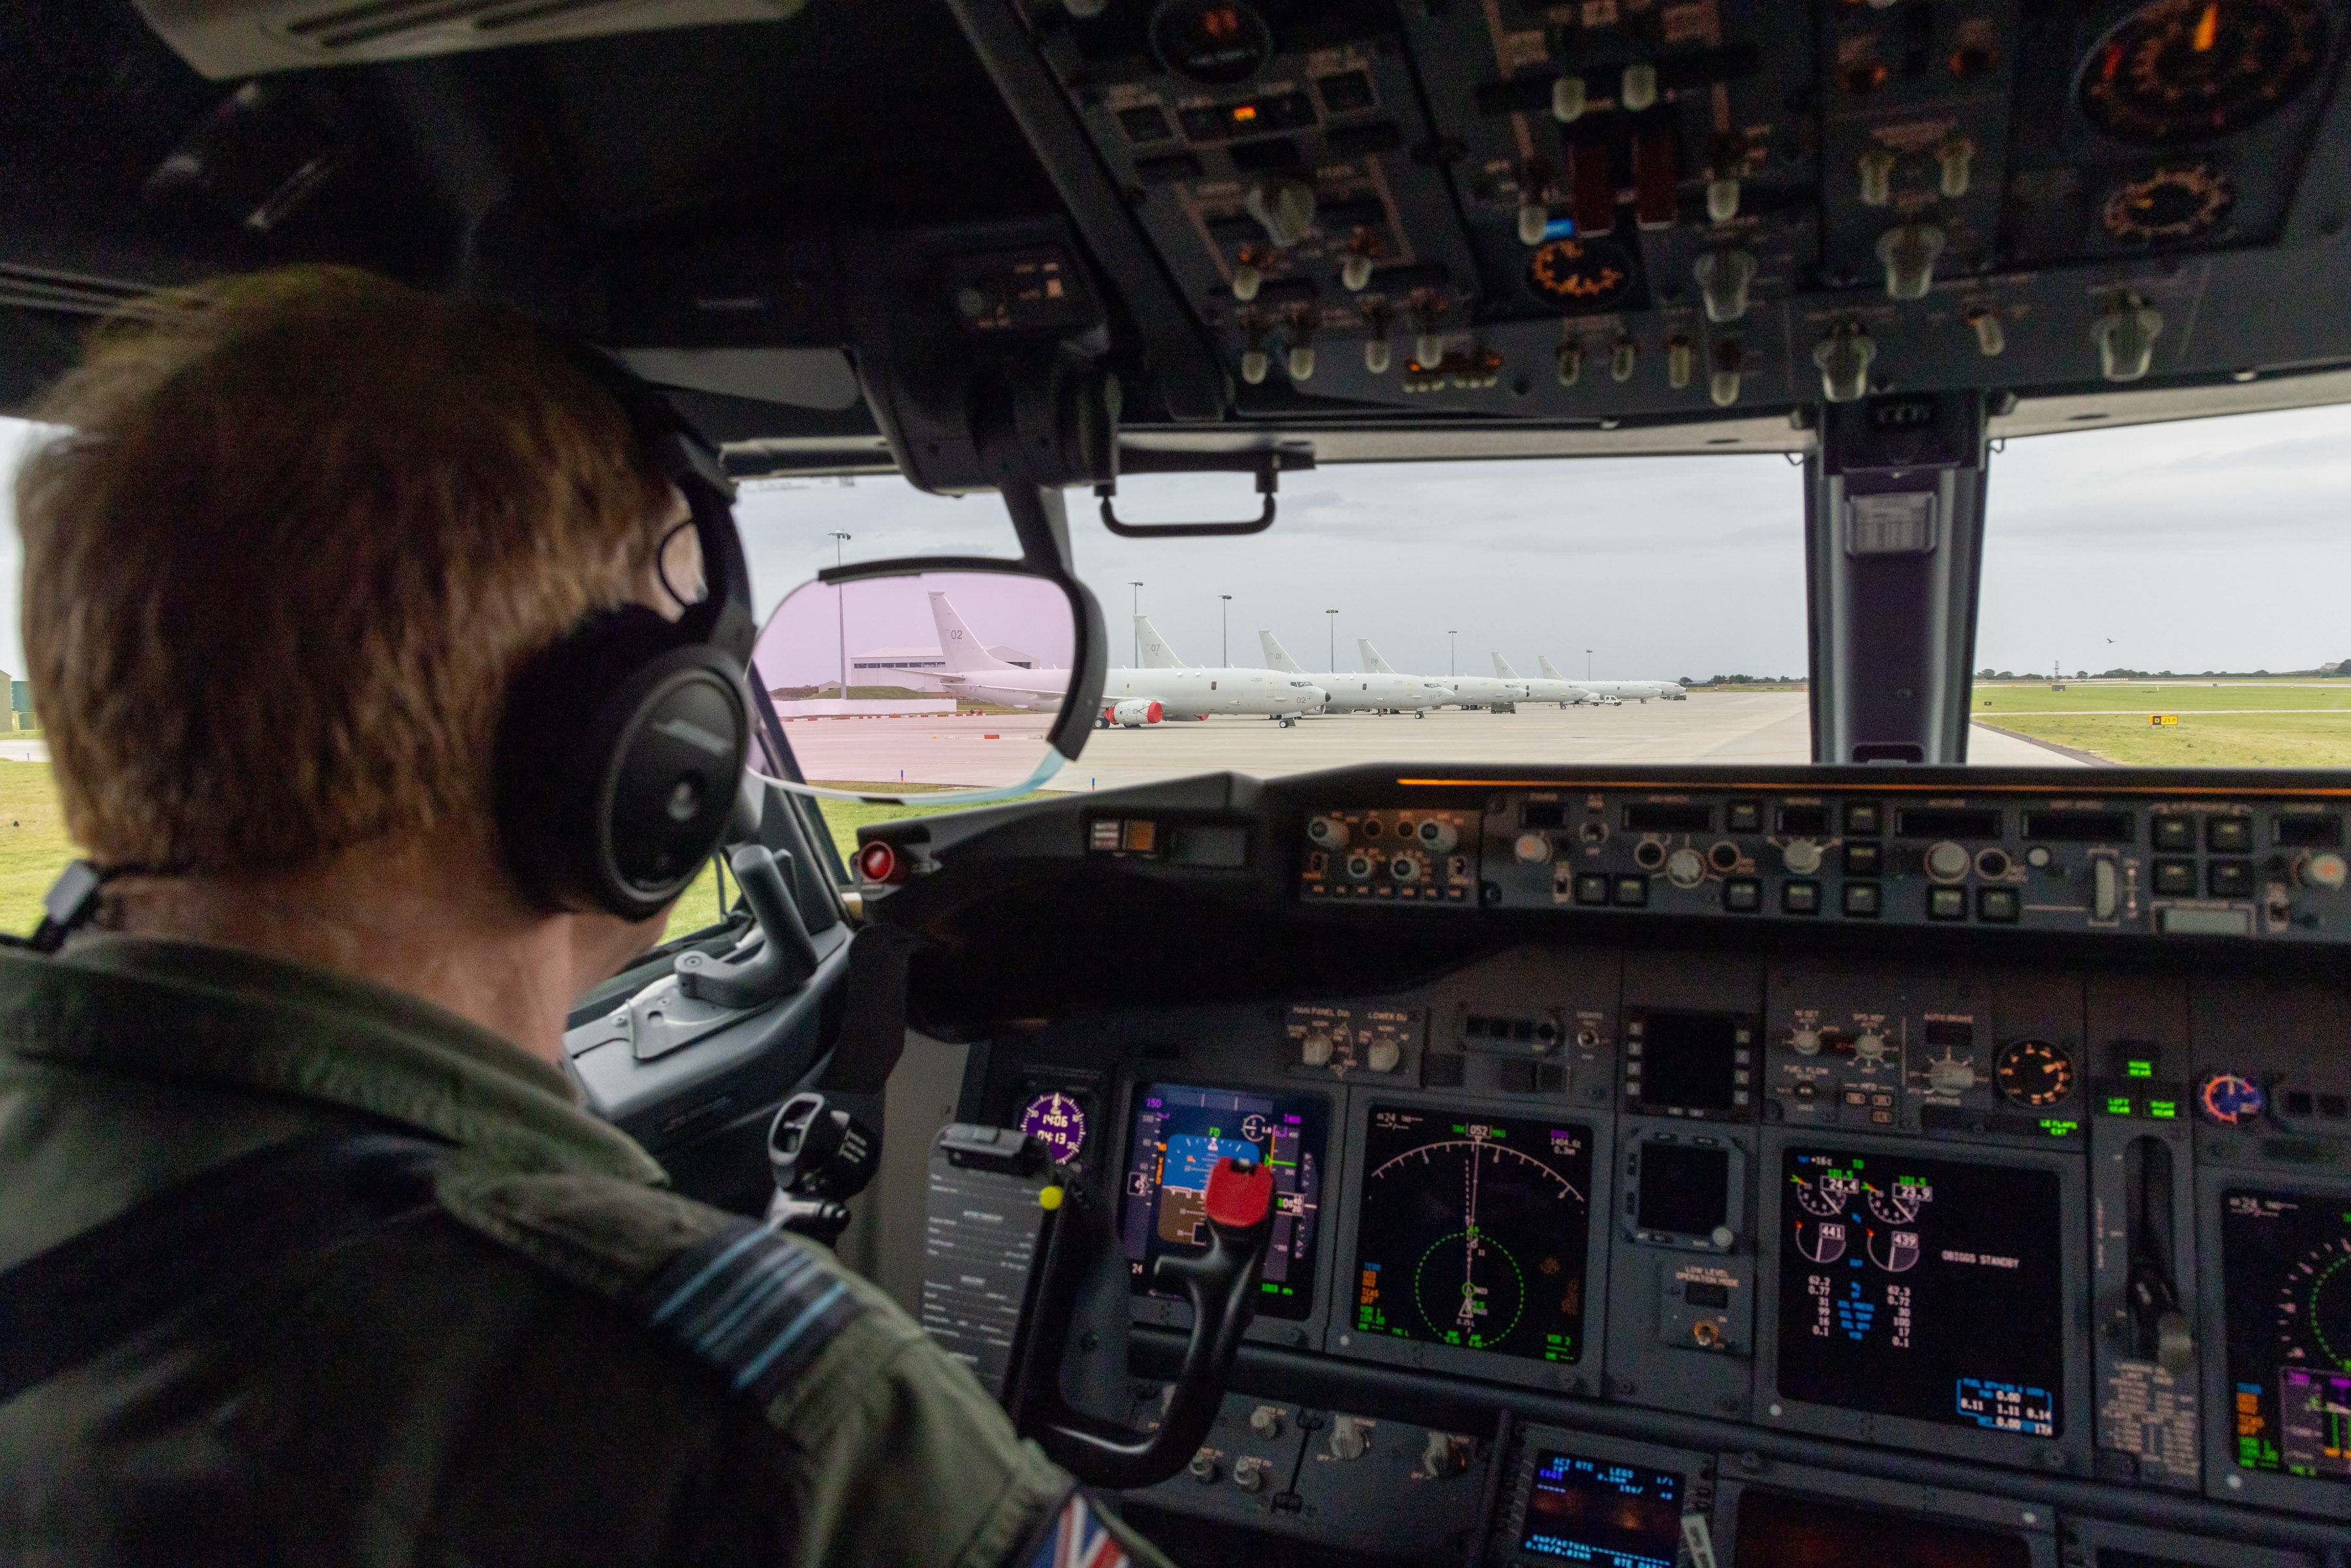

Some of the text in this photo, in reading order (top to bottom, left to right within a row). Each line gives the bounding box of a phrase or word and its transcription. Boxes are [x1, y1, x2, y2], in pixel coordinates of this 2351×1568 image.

[951, 630, 963, 639] 02
[1146, 1098, 1162, 1108] 150
[2107, 1106, 2130, 1114] GEAR
[1042, 1113, 1068, 1128] 14:06
[2051, 1119, 2077, 1130] FLAPS
[1209, 1127, 1221, 1138] FD
[1469, 1125, 1489, 1138] 052
[2050, 1127, 2068, 1136] EXT
[1853, 1159, 1864, 1169] TO
[1829, 1177, 1857, 1192] 24.4
[1900, 1185, 1931, 1200] 23.9
[1821, 1226, 1842, 1238] 441
[1894, 1234, 1917, 1247] 439
[1979, 1254, 2019, 1268] STANDBY
[1132, 1263, 1143, 1274] 24
[1704, 1267, 1729, 1279] LEVEL
[1808, 1285, 1831, 1296] 0.77
[1887, 1295, 1911, 1307] 0.72
[1812, 1325, 1829, 1336] 0.1
[1898, 1327, 1910, 1337] 17
[1892, 1336, 1910, 1348] 0.1
[1996, 1390, 2021, 1403] 0.00
[1997, 1403, 2020, 1416] 1.11
[1553, 1456, 1571, 1468] ACT
[1575, 1460, 1594, 1472] RTE
[1608, 1467, 1634, 1479] LEGS
